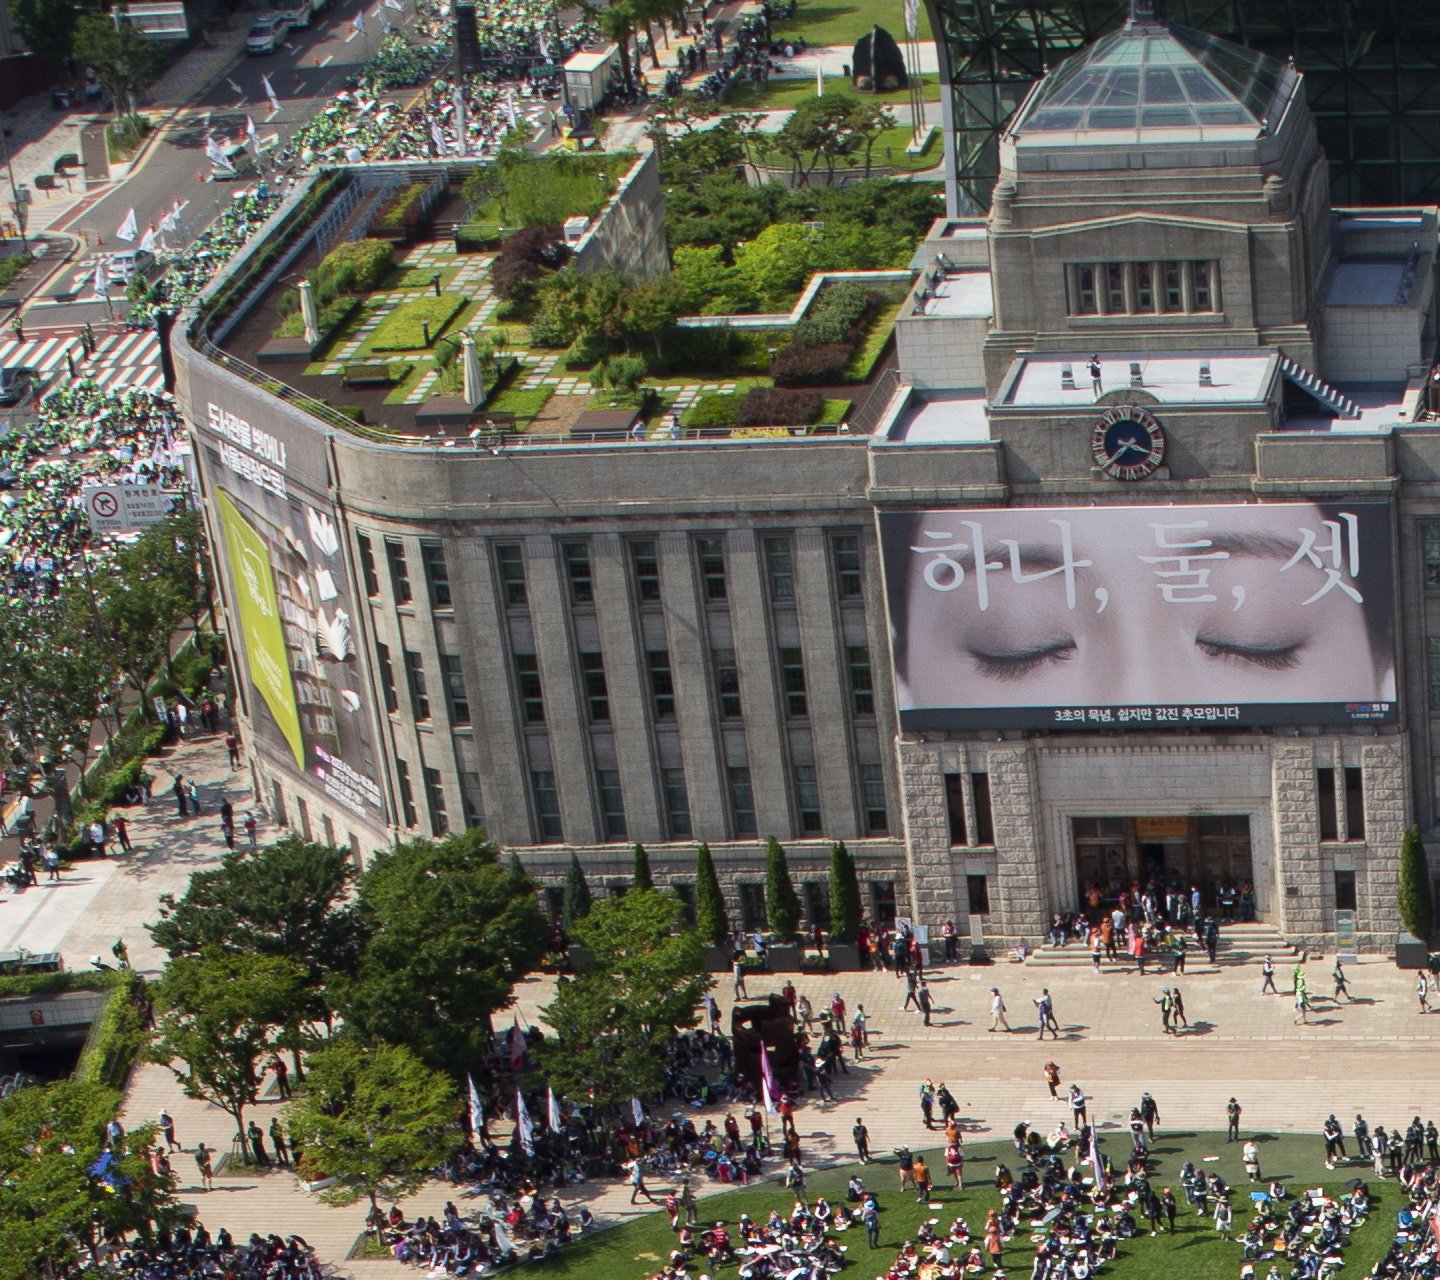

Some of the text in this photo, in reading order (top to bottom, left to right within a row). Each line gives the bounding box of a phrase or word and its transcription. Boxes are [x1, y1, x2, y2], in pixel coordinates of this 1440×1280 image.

[910, 512, 1364, 612] 하나, 둘, 셋
[1054, 709, 1085, 722] 3초의
[1117, 708, 1151, 721] 쉽지만
[1155, 707, 1179, 721] 값진
[1181, 706, 1240, 721] 추모입니다
